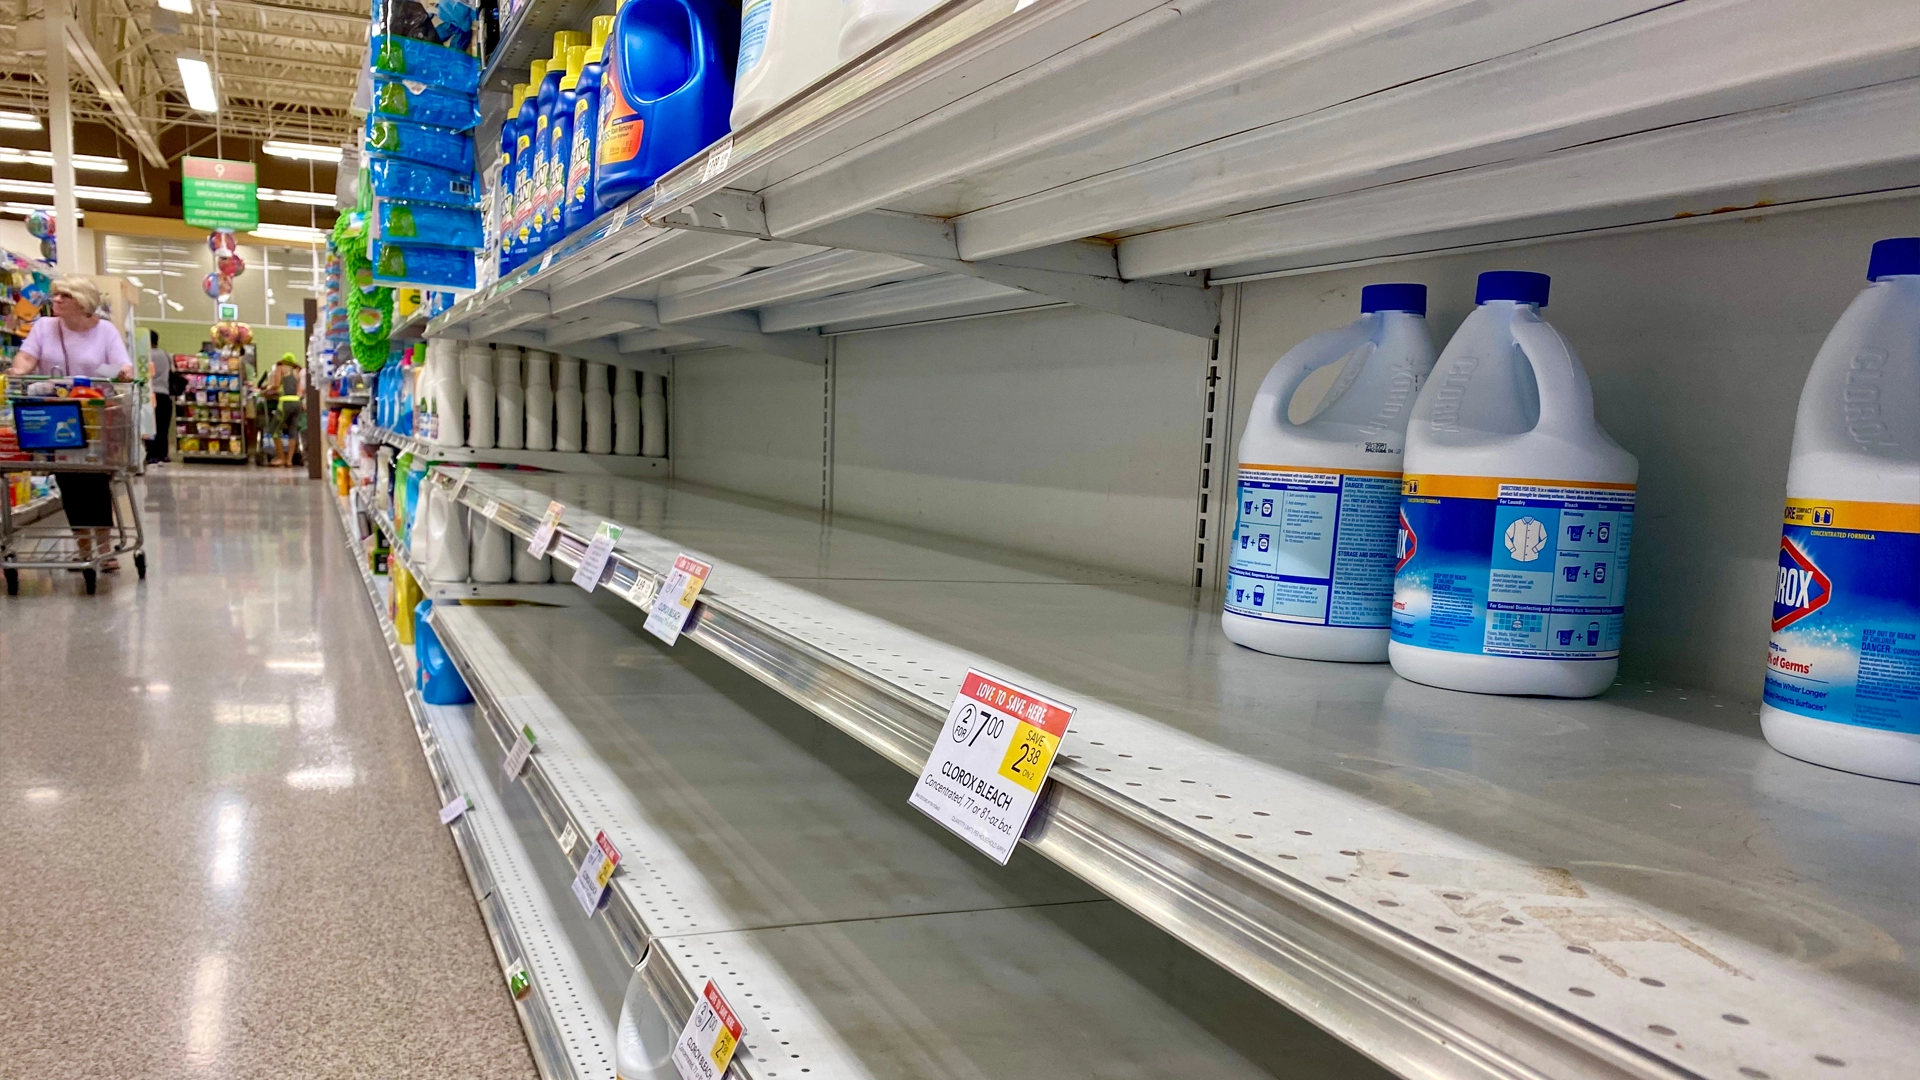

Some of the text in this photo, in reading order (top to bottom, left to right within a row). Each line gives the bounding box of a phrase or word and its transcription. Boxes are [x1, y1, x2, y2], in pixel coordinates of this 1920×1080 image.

[215, 164, 225, 178] 9
[1785, 506, 1796, 519] ORE
[1811, 530, 1875, 540] CONCENTRATED FORMULA
[1870, 636, 1896, 644] CHILDREN
[1897, 632, 1916, 640] REACH
[1861, 642, 1892, 653] DANGER:
[1773, 655, 1779, 666] of
[1783, 682, 1801, 693] Whiter
[976, 682, 1048, 725] LOVE TO SAVE HERE.
[1776, 695, 1794, 705] Protects
[962, 708, 972, 724] 2
[955, 725, 967, 738] FOR
[1026, 730, 1046, 747] SAVE
[1022, 769, 1030, 779] ON
[942, 761, 978, 791] CLOROX
[975, 780, 1013, 811] BLEACH
[924, 774, 965, 808] Concentrated,
[964, 797, 975, 810] 77
[972, 805, 981, 815] or
[979, 807, 999, 827] 81-oz
[998, 817, 1012, 836] bot.
[701, 1005, 706, 1015] 2
[687, 1037, 714, 1079] CLOROX BLEACH
